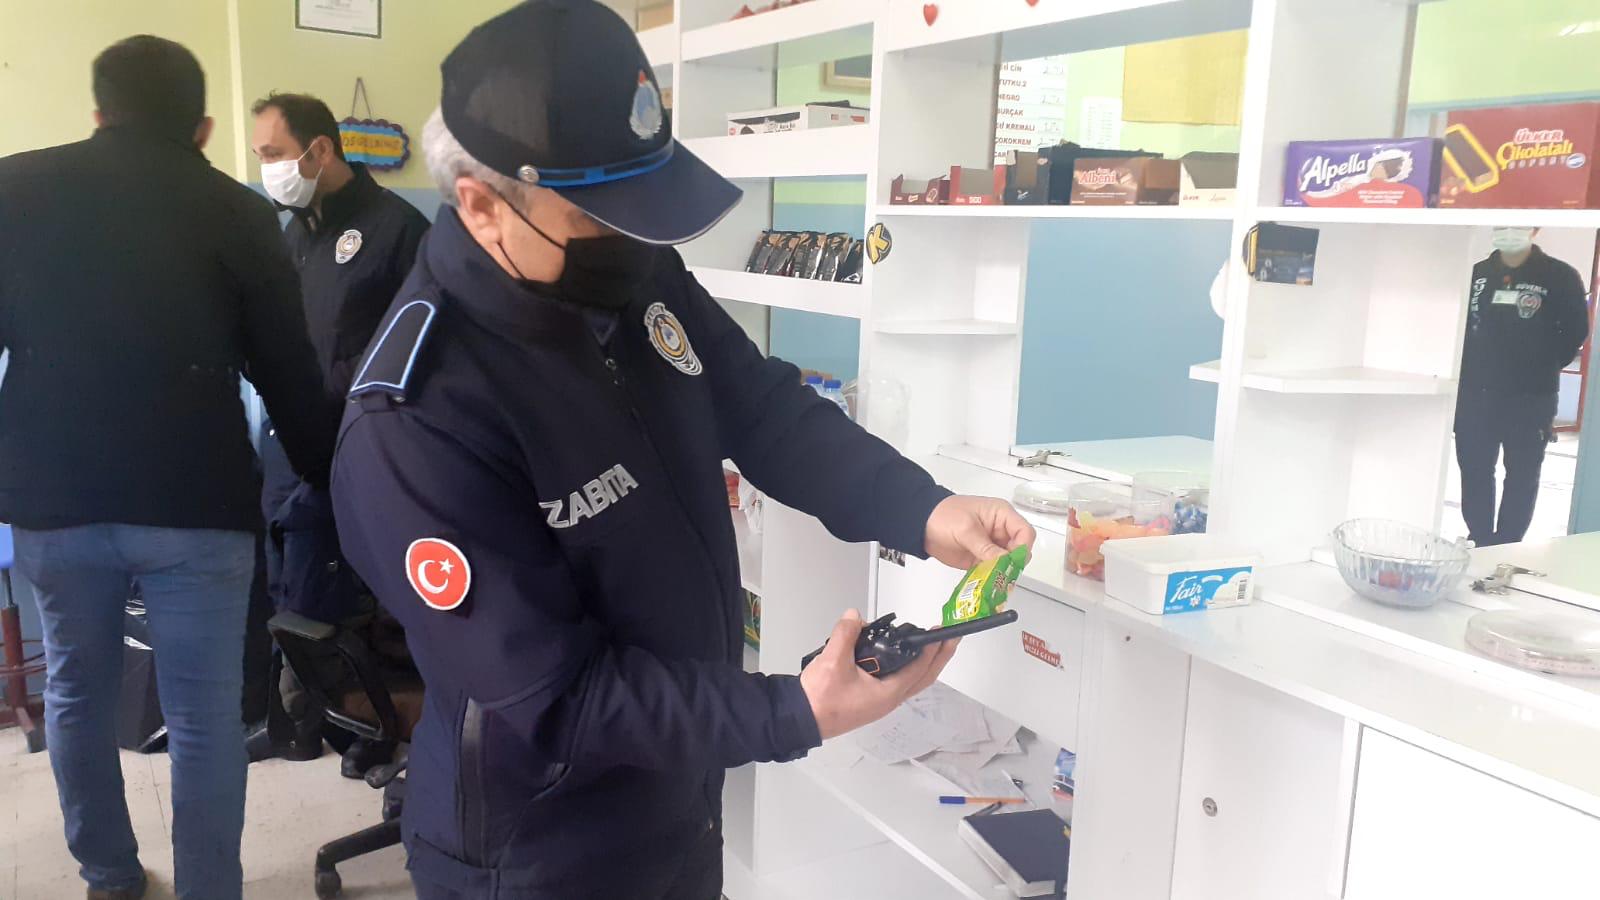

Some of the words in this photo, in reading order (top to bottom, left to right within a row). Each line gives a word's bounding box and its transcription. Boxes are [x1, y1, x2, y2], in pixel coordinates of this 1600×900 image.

[1496, 139, 1574, 170] Çikolatalı
[1078, 169, 1118, 185] Albeni
[1299, 153, 1366, 192] Alpella
[538, 463, 639, 529] ZABITA
[1169, 575, 1203, 603] Fair
